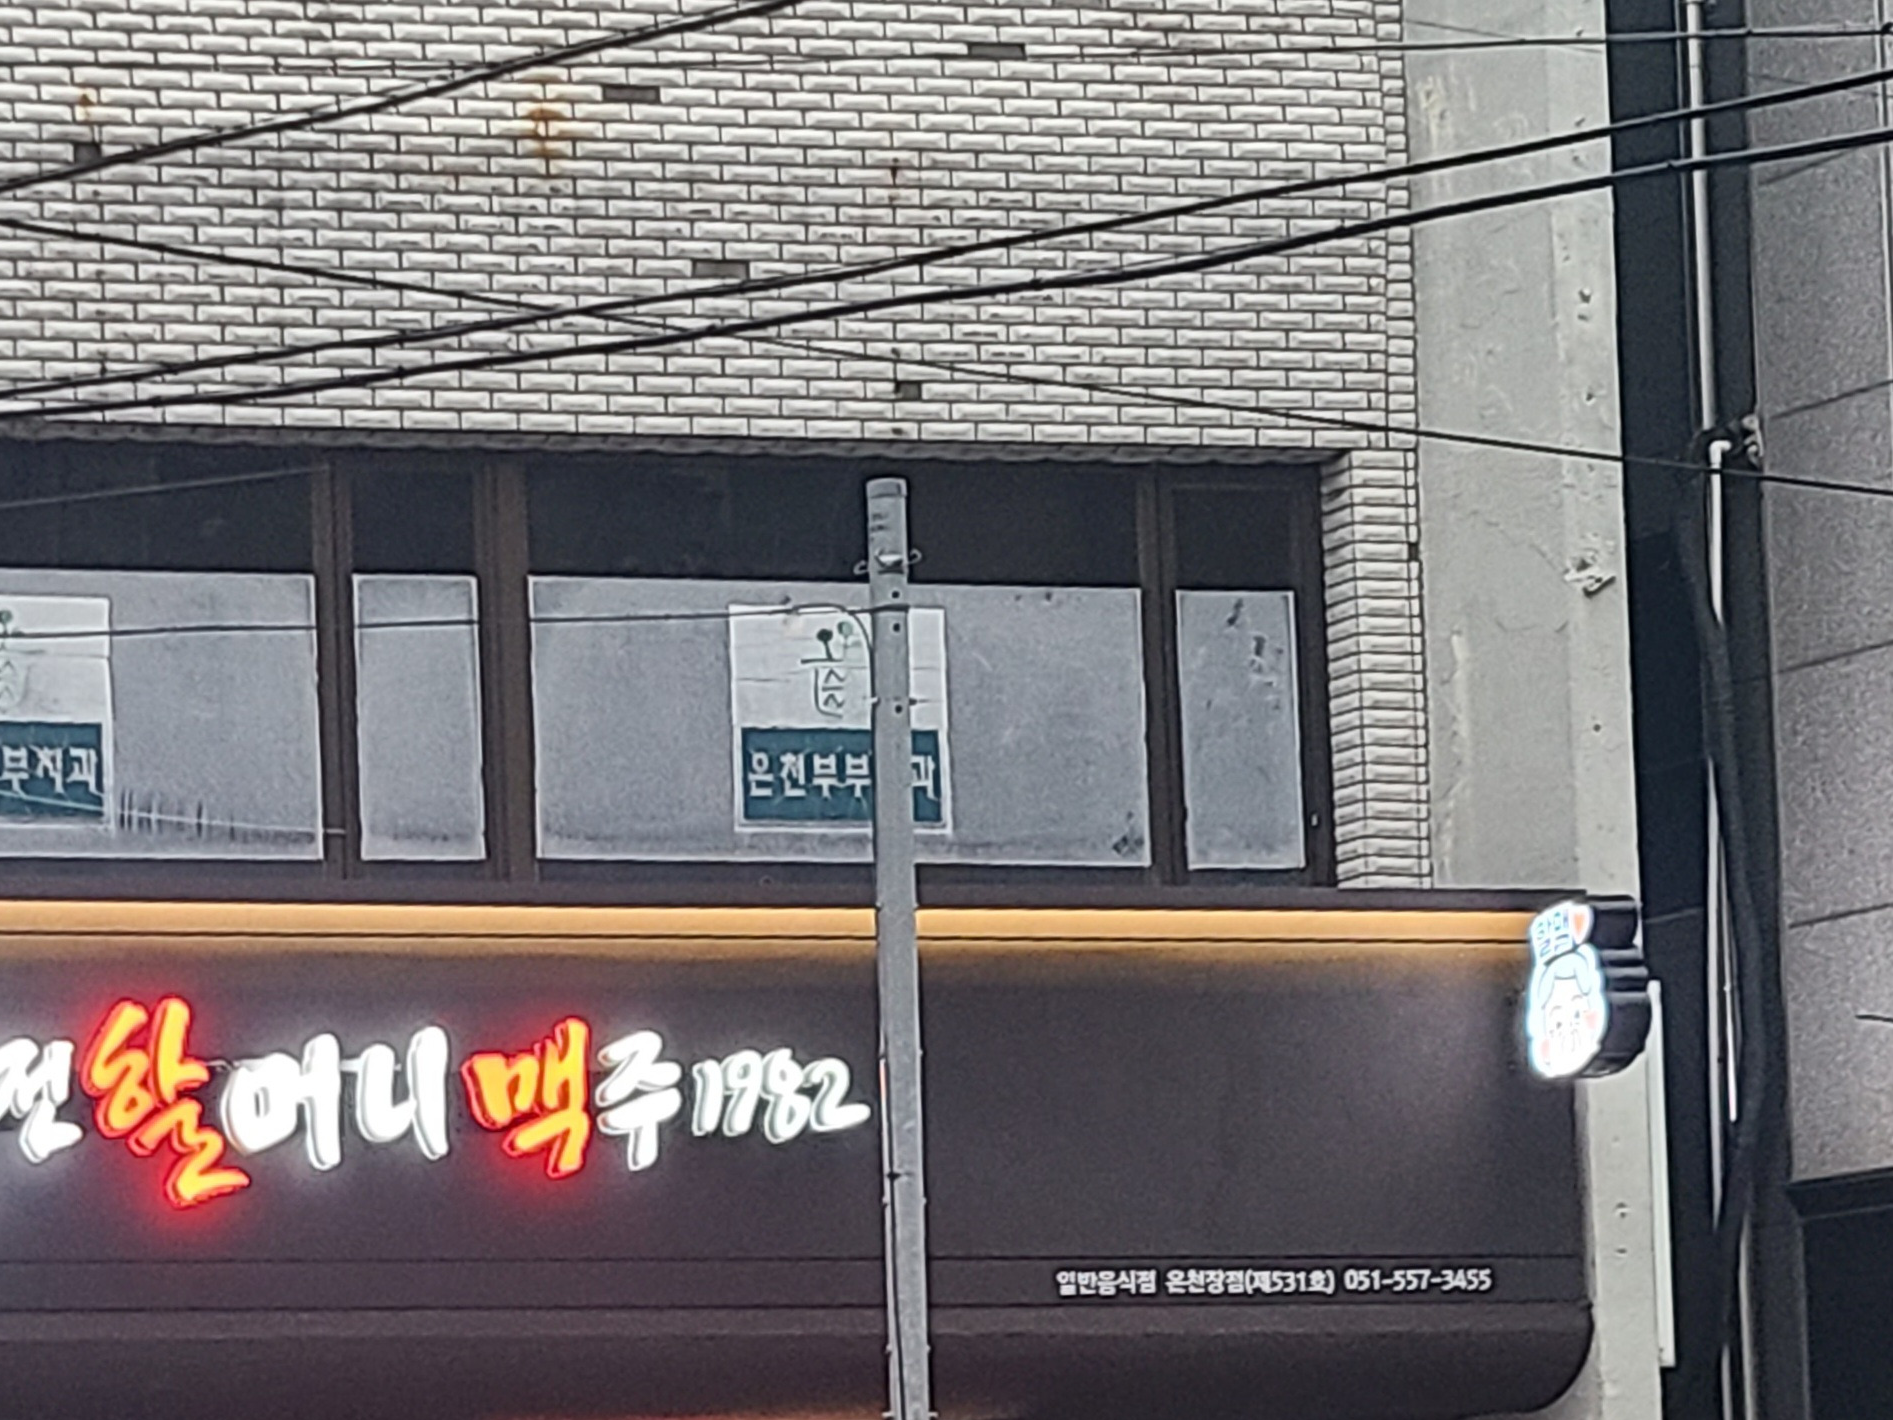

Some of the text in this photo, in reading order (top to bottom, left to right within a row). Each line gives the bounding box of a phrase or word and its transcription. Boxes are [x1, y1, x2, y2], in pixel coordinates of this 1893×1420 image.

[746, 750, 940, 800] 온천부부과
[1056, 1268, 1157, 1297] 일반음식점
[1343, 1267, 1493, 1292] 051-557-3455
